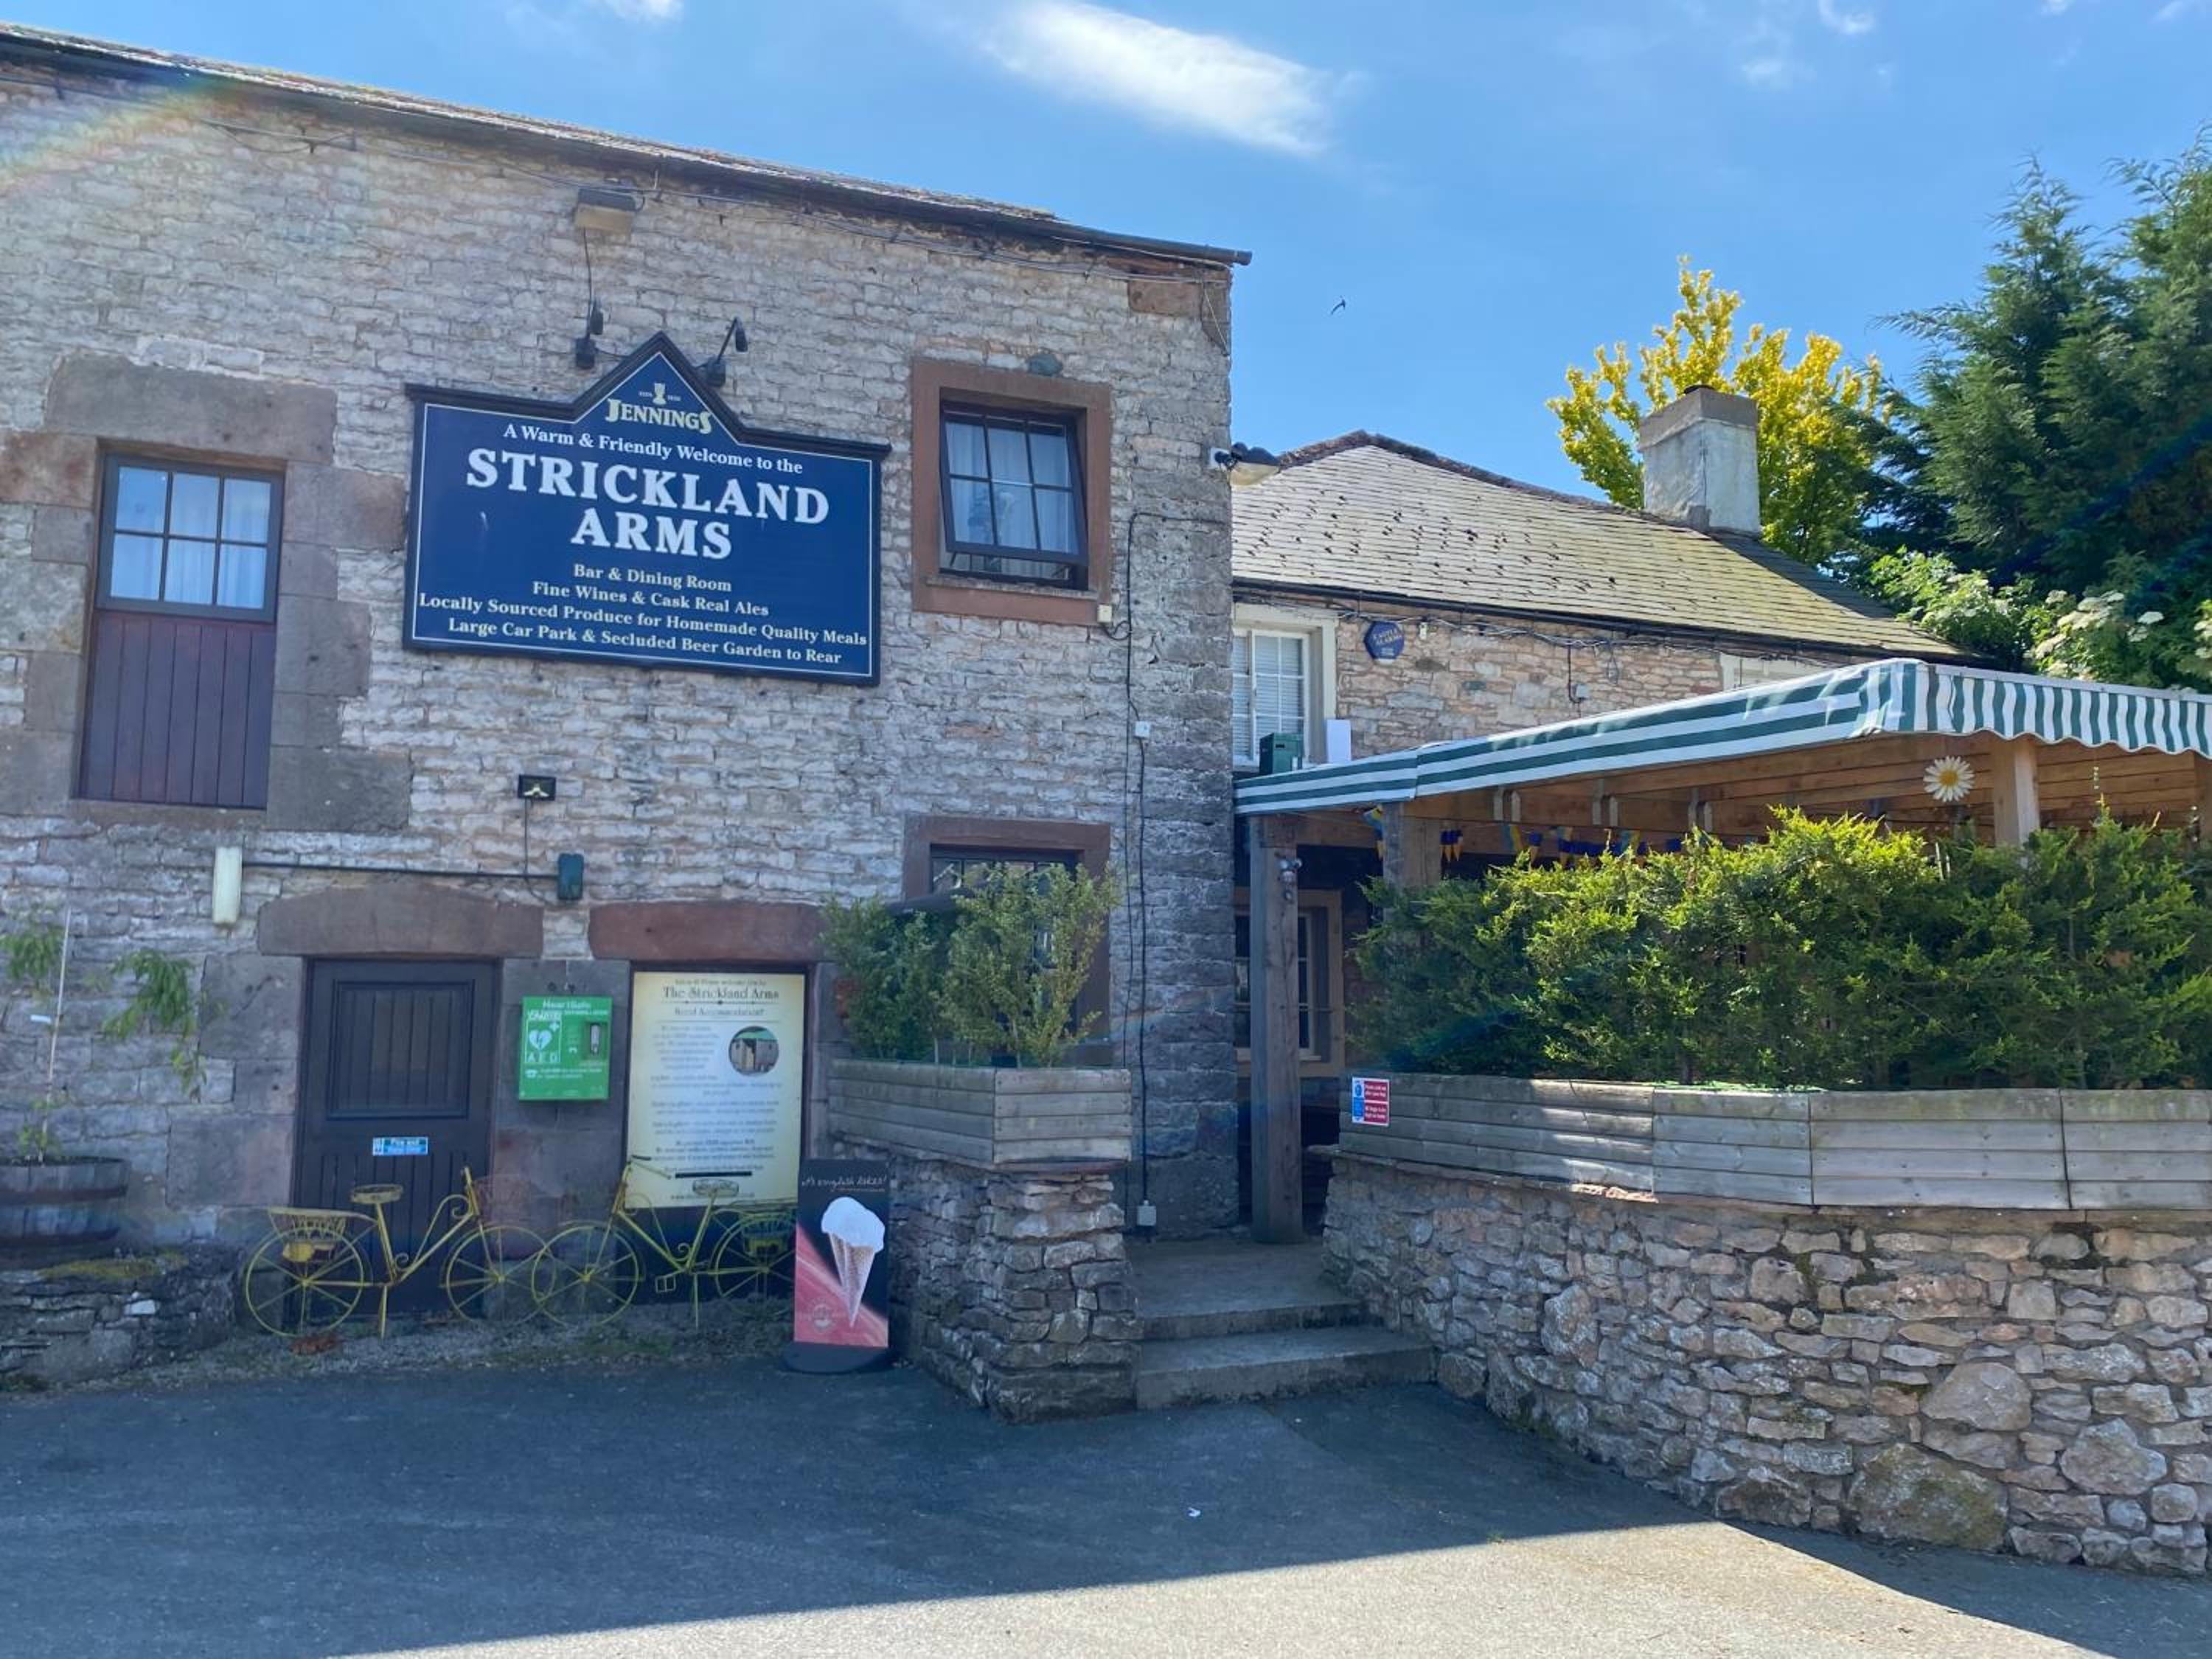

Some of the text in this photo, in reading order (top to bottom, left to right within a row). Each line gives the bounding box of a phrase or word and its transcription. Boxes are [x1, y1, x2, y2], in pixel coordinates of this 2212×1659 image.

[605, 397, 713, 434] JENNINGS
[504, 424, 802, 473] A Warm & Friendly Welcome to the
[467, 448, 830, 524] STRICKLAND
[571, 507, 731, 559] ARMS
[534, 582, 768, 616] Fine Wines & Cask Real Ales
[574, 564, 731, 591] Bar & Dining Room
[420, 593, 866, 644] Locally Sourced Produce for Homemade Quality Meals
[449, 618, 841, 663] Large Car Park & Secluded Beer Garden to Rear
[663, 986, 779, 999] The Strickland Arms
